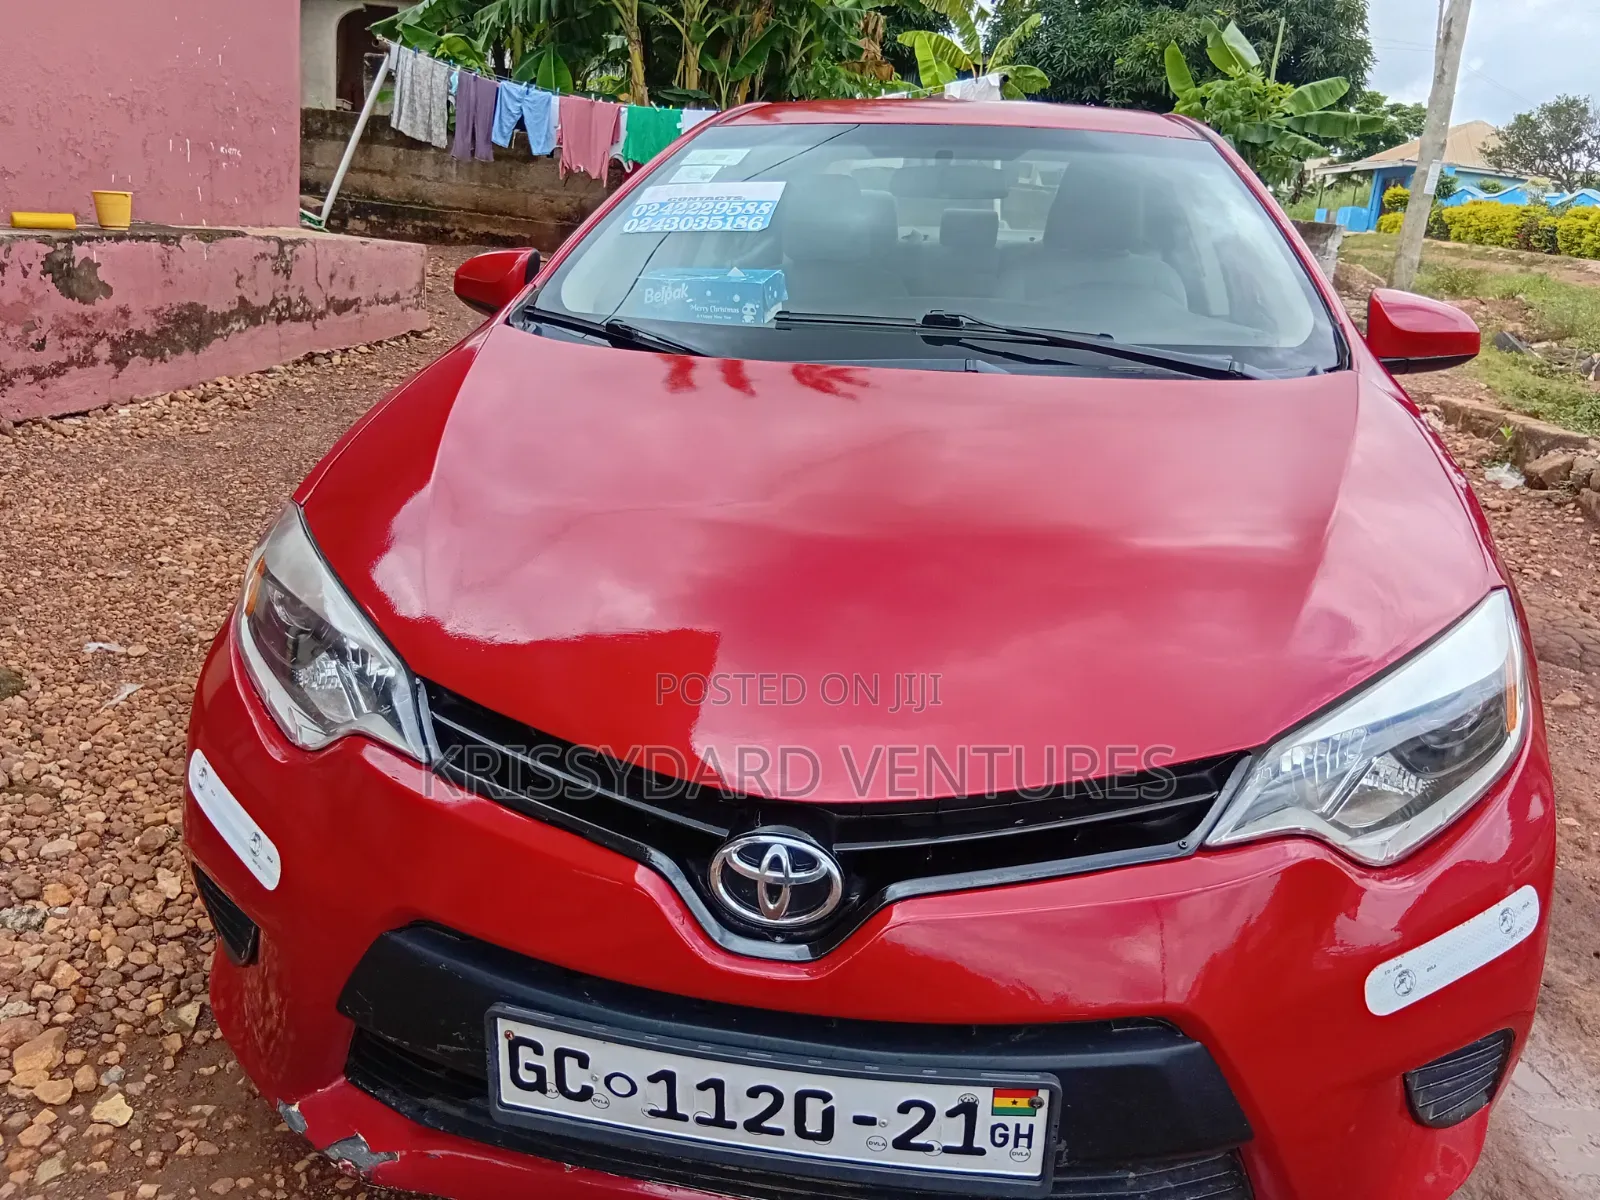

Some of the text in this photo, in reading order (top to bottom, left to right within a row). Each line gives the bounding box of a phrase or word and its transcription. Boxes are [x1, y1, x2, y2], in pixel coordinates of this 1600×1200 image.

[632, 201, 773, 217] 0242229588
[622, 215, 764, 233] 0243035186
[643, 282, 689, 305] Belpak
[689, 303, 740, 314] Merry Christmas
[508, 1035, 595, 1102] GC
[868, 1140, 887, 1148] DVLA
[989, 1122, 1034, 1150] GH
